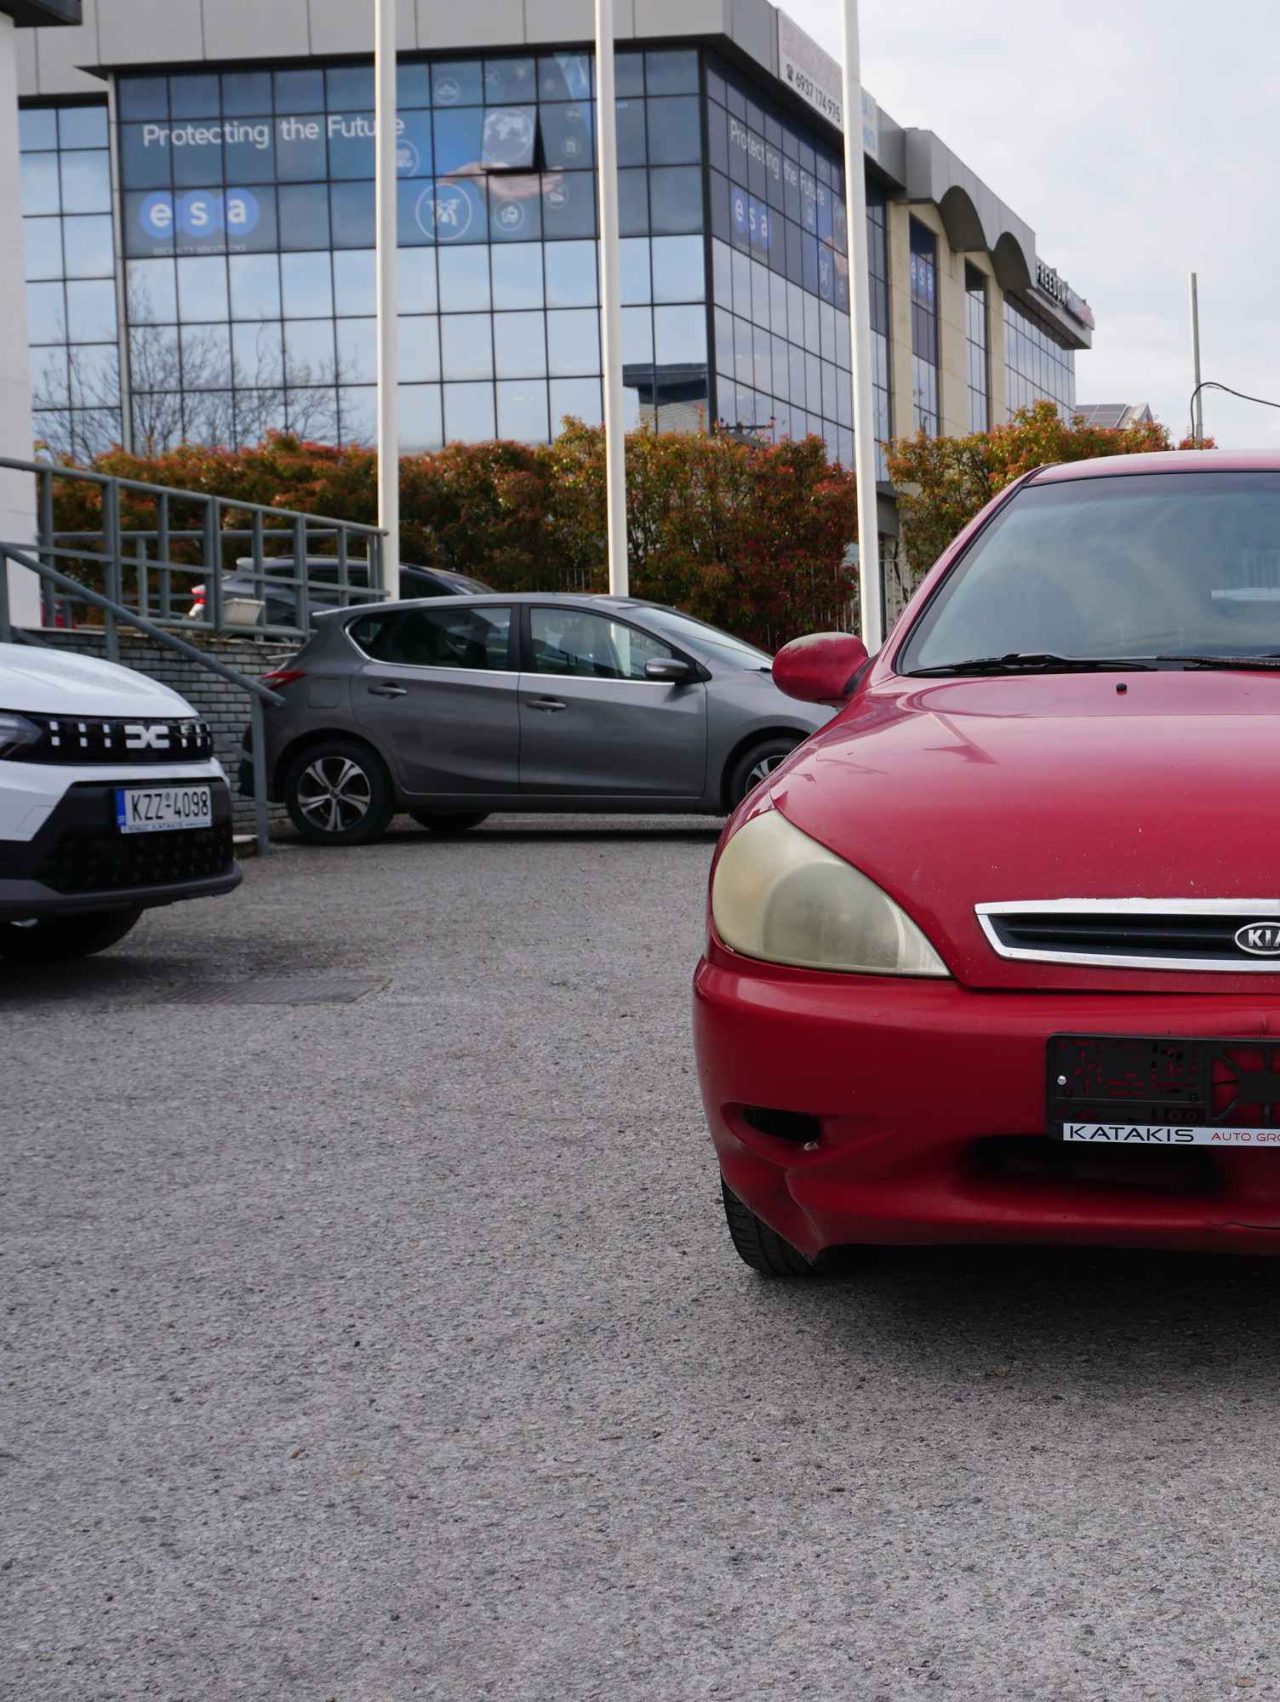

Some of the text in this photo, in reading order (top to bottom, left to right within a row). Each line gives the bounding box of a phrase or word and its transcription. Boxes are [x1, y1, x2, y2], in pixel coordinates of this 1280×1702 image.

[795, 72, 814, 98] 6937
[143, 115, 405, 149] Protecting the Futue
[731, 120, 780, 180] Protecting
[149, 198, 248, 228] esa
[735, 198, 768, 239] esa
[911, 260, 934, 293] esa
[131, 791, 209, 822] KZZ-4098
[1069, 1125, 1195, 1143] KATAKIS
[1211, 1131, 1251, 1142] AUTO
